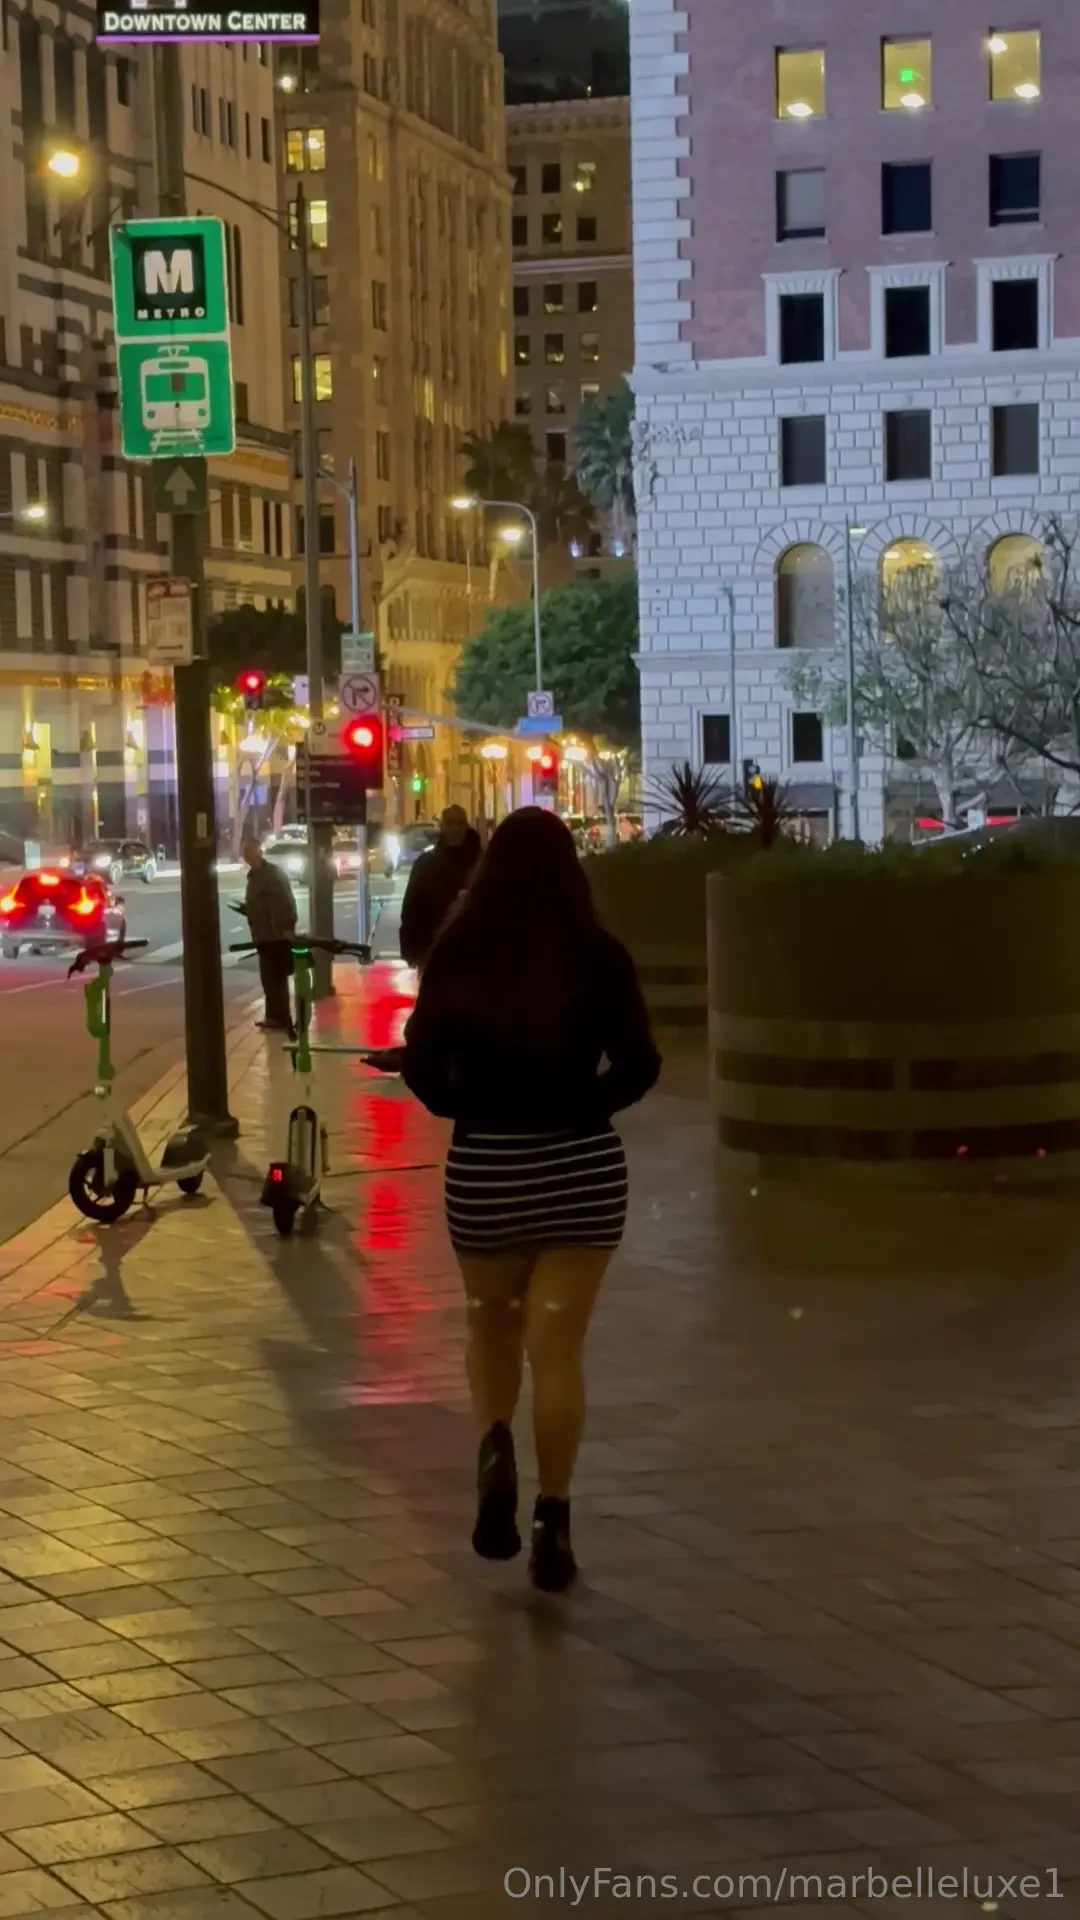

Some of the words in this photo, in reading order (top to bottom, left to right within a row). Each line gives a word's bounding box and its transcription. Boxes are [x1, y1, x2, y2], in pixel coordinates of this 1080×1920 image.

[104, 12, 221, 31] DOWNTOWN
[227, 11, 306, 30] CENTER
[144, 249, 194, 294] M
[137, 306, 205, 319] METRO
